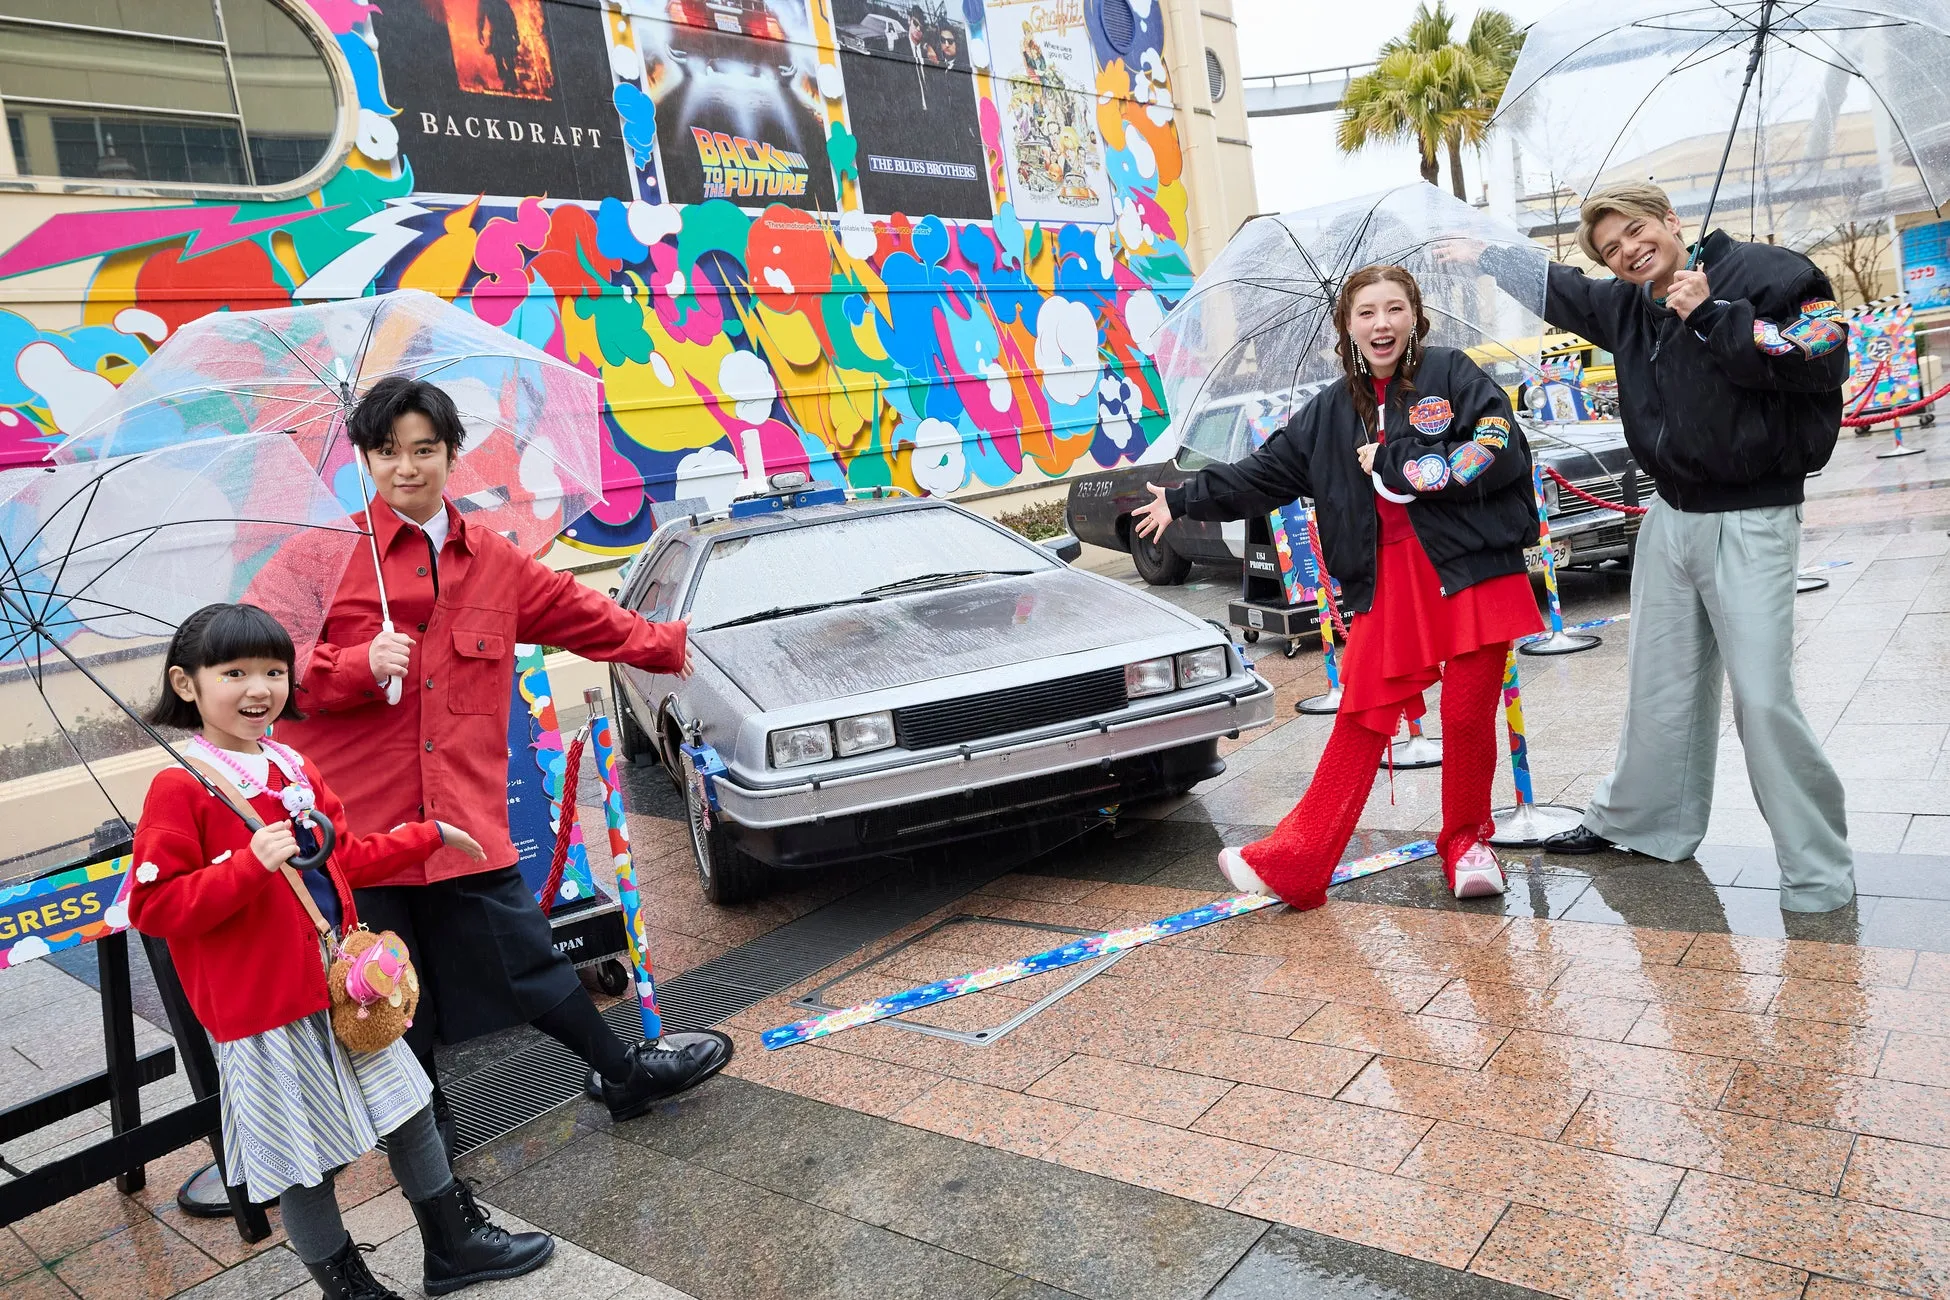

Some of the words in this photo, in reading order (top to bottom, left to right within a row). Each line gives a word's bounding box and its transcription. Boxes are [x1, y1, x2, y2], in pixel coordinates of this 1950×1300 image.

[420, 112, 601, 148] BACKDRAFT
[691, 126, 790, 172] BACK
[703, 166, 724, 183] TO
[870, 157, 894, 171] THE
[893, 159, 925, 174] BLUES
[925, 162, 976, 178] BROTHERS
[703, 183, 725, 198] THE
[724, 167, 809, 197] FUTURE
[1256, 551, 1266, 560] USJ
[1249, 560, 1275, 571] PROPERTY
[553, 936, 584, 952] APAN
